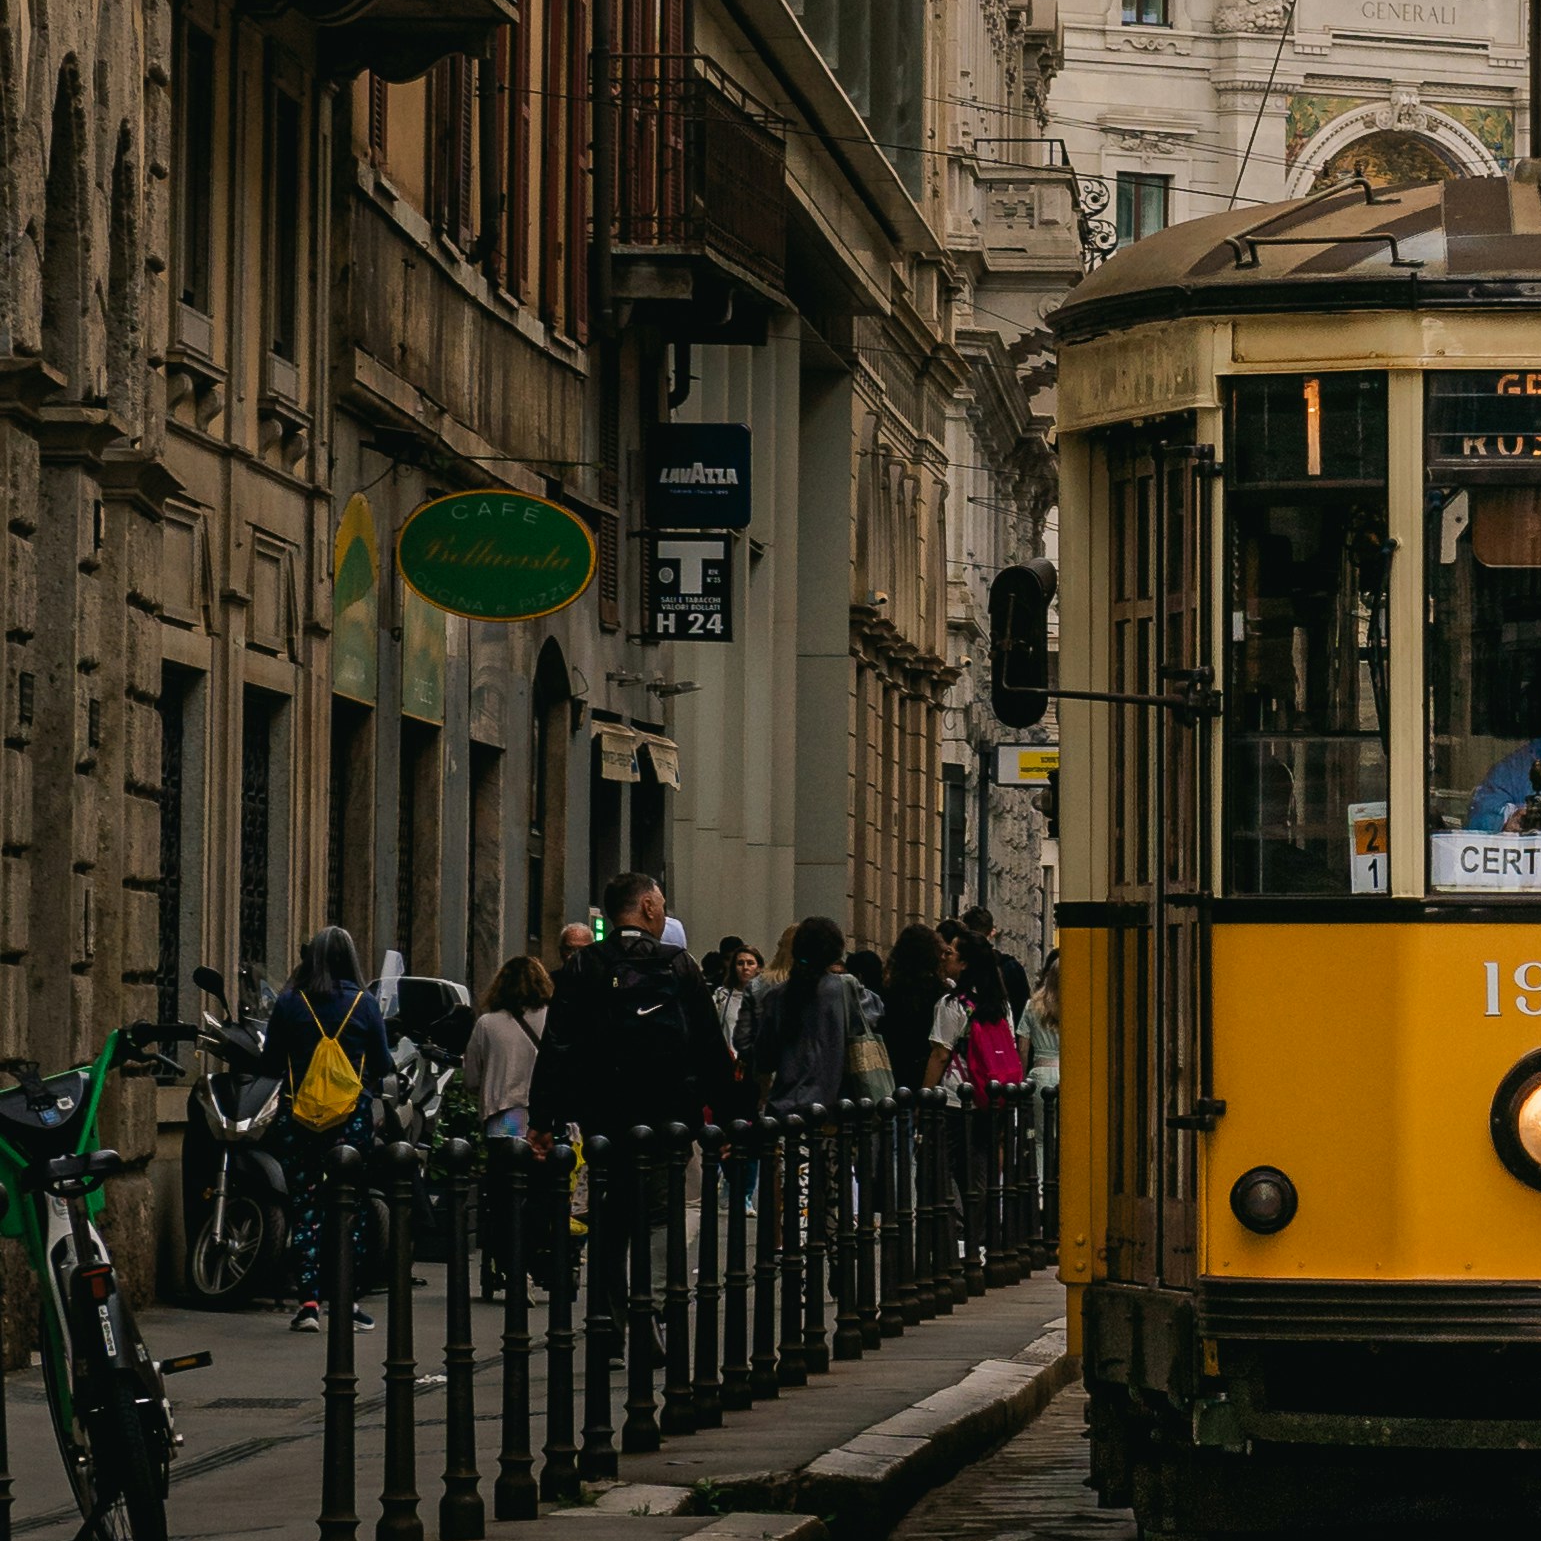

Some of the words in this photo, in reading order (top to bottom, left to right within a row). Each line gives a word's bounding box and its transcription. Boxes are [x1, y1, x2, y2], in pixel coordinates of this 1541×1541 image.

[1361, 1, 1456, 25] GENERALI
[659, 462, 739, 484] LAVAZZA
[451, 501, 545, 525] CAFÉ
[413, 571, 484, 612] CUCINA
[518, 579, 573, 611] PIZZE
[657, 613, 676, 634] H
[687, 613, 724, 634] 24
[1363, 822, 1380, 852] 2
[1367, 858, 1380, 889] 1
